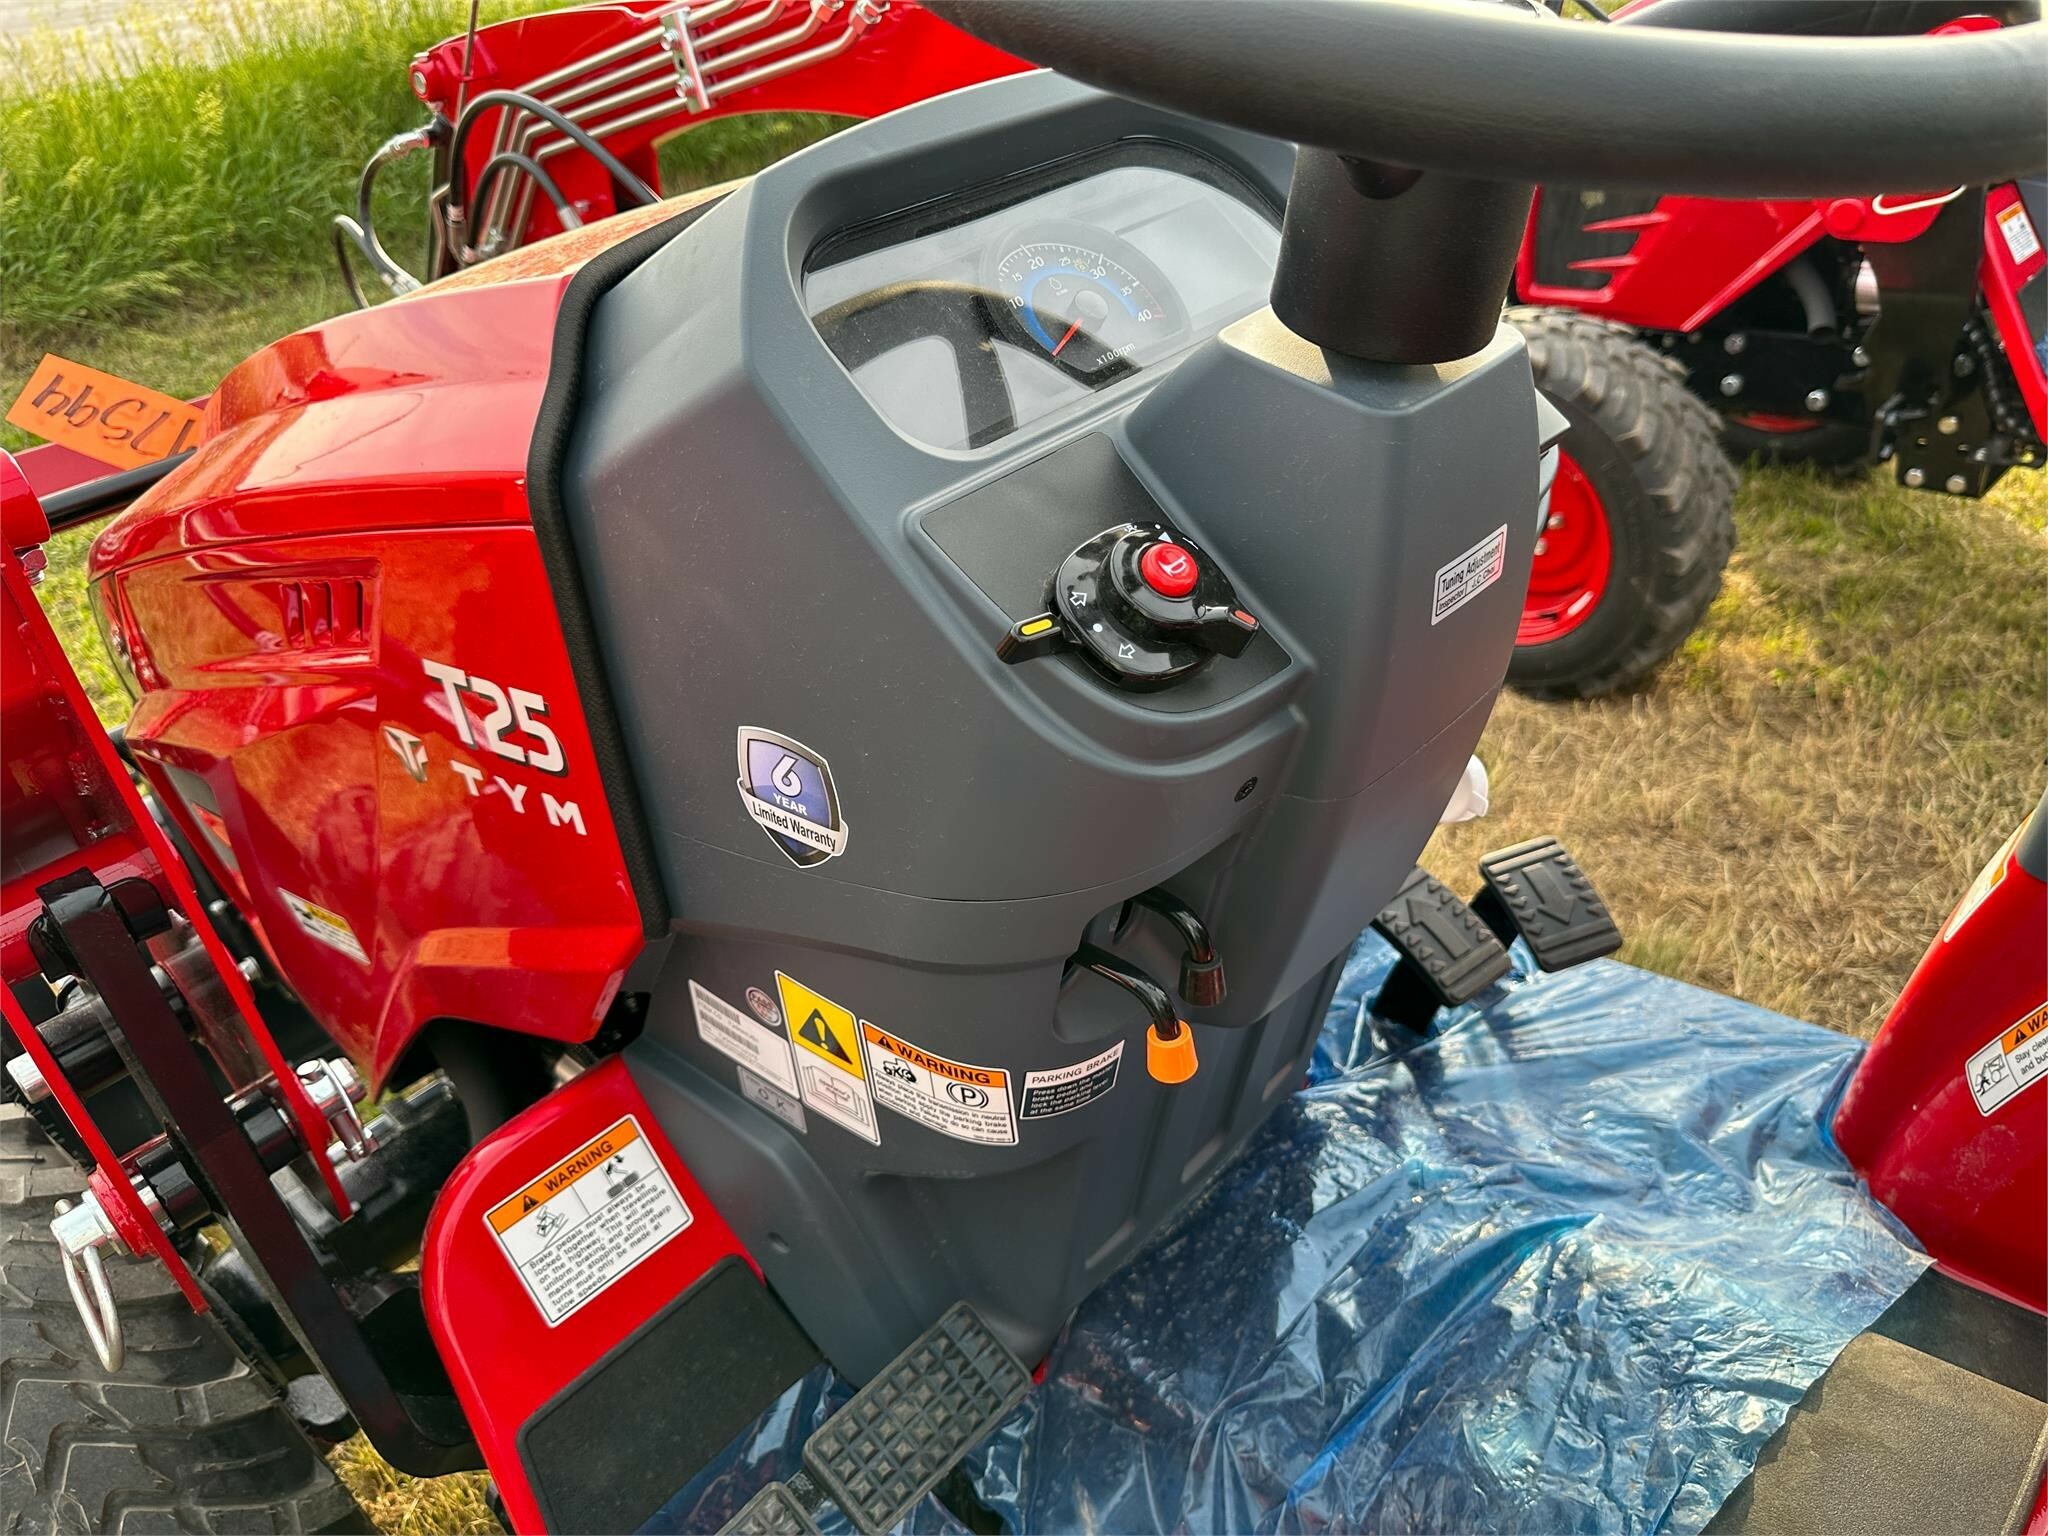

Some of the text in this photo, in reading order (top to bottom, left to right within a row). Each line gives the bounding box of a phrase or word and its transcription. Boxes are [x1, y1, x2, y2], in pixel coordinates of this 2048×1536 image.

[1027, 255, 1045, 270] 20
[1058, 256, 1071, 267] 25
[1089, 266, 1106, 280] 30
[1011, 272, 1023, 283] 15
[1120, 285, 1133, 297] 35
[1008, 295, 1025, 310] 10
[1136, 308, 1152, 324] 40
[1442, 541, 1501, 593] Tuning Adjustment
[422, 658, 568, 776] T25
[771, 754, 802, 798] 6
[773, 792, 808, 816] YEAR
[752, 801, 836, 852] Limited Warranty
[896, 1042, 990, 1085] WARNING
[1032, 1047, 1119, 1084] PARKING BRAKE
[2014, 1047, 2030, 1064] Stay
[2020, 1061, 2035, 1075] and
[1032, 1095, 1054, 1103] brake
[1033, 1088, 1055, 1096] Press
[544, 1140, 614, 1193] WARNING
[529, 1183, 646, 1269] Brake pedals must always be
[534, 1184, 658, 1276] locked together when travelling
[539, 1274, 551, 1284] on
[552, 1262, 566, 1274] the
[606, 1220, 623, 1233] This
[625, 1207, 639, 1220] will
[641, 1188, 666, 1209] ensure
[544, 1207, 654, 1291] uniform braking and provide
[548, 1205, 672, 1299] maximum stopping ability sharp
[552, 1221, 662, 1306] turns must only be made at
[557, 1297, 575, 1313] slow
